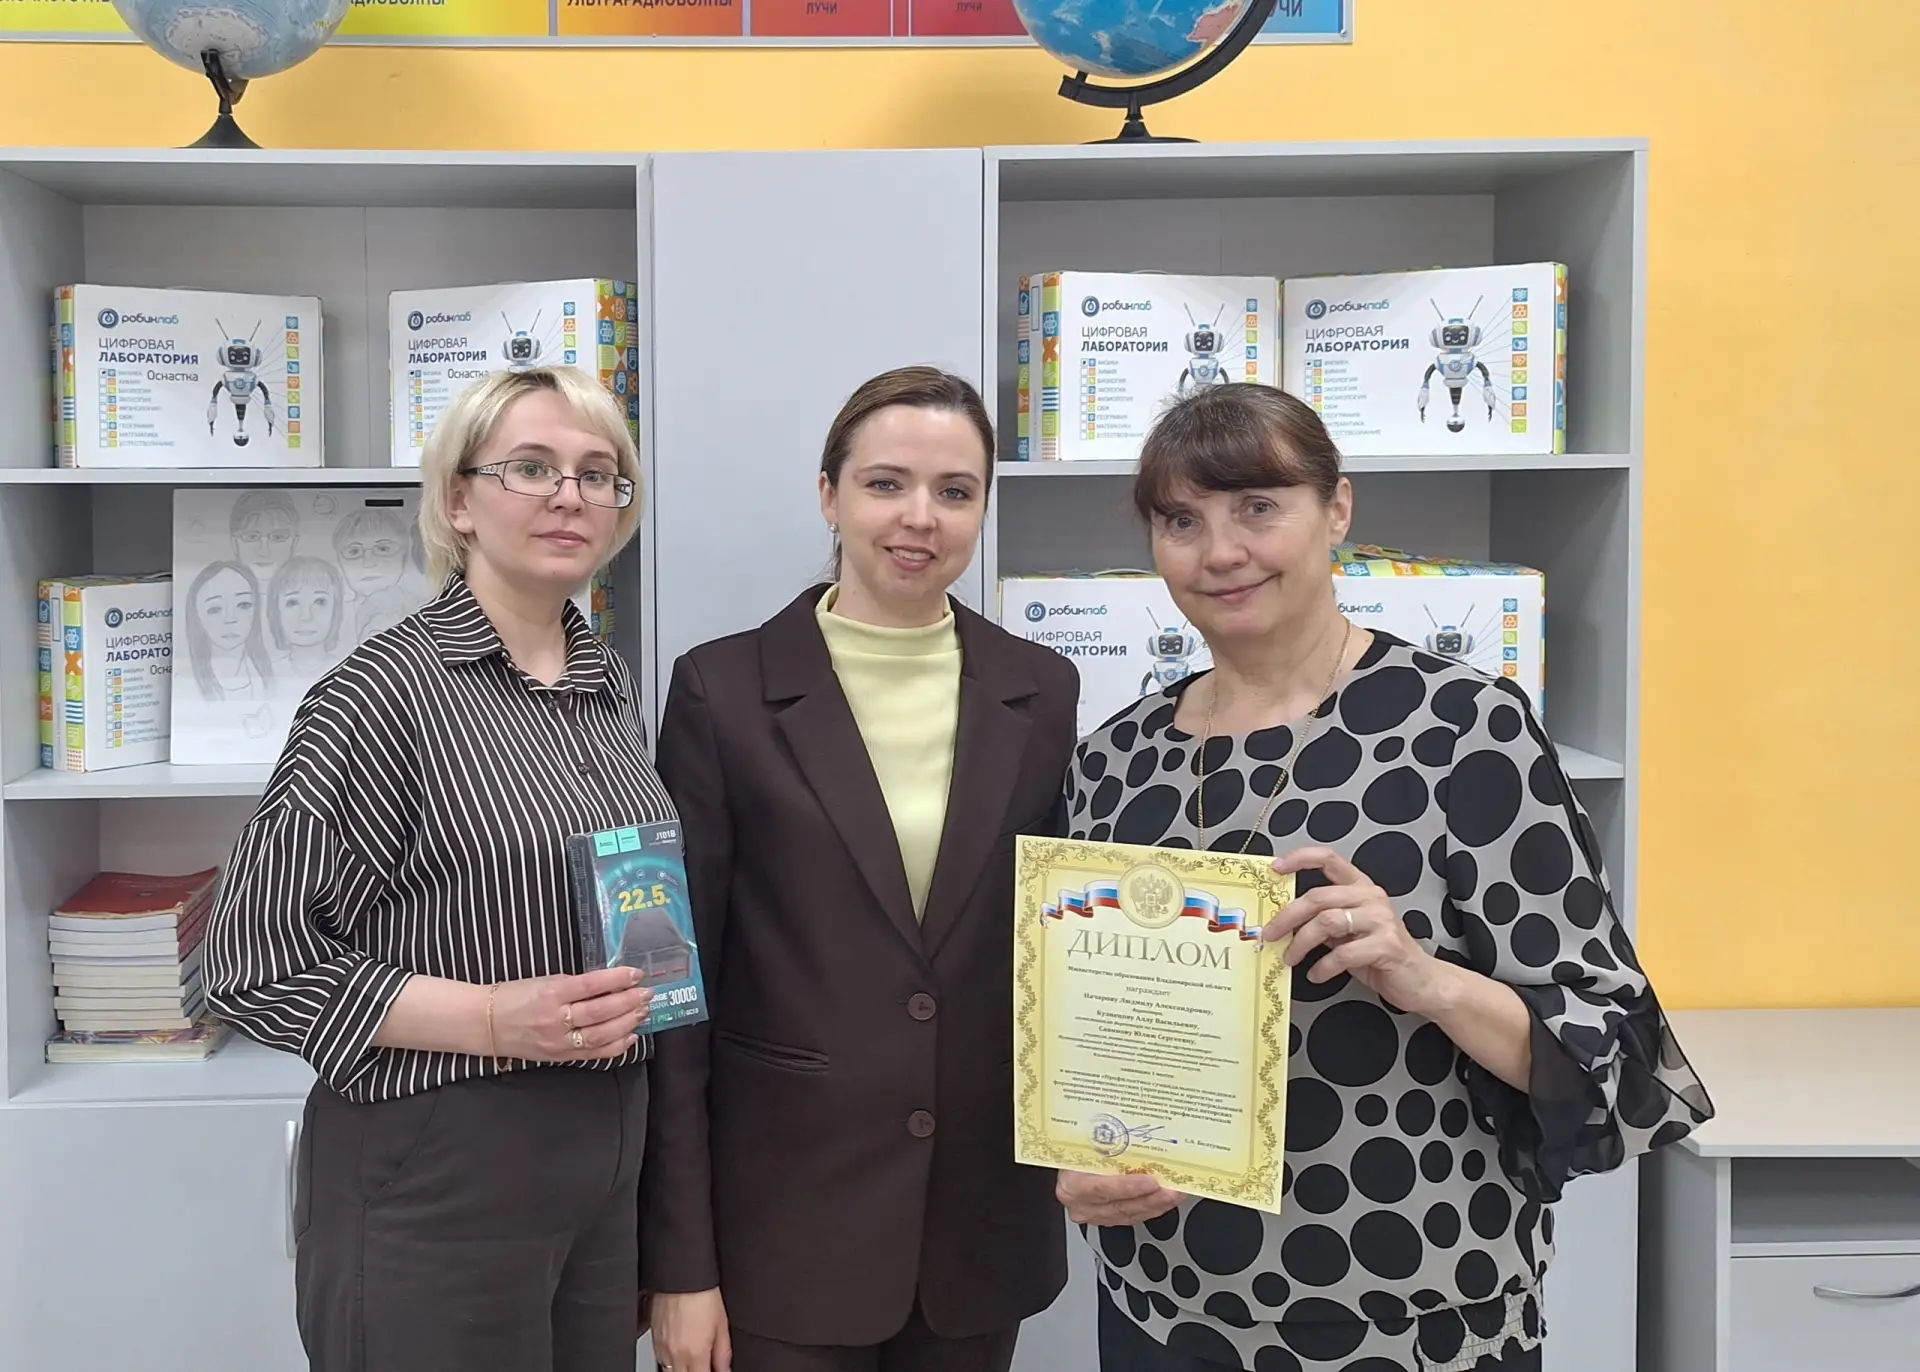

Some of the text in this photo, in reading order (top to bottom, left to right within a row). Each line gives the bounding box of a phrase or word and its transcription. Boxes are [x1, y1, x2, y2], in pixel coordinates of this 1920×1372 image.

[806, 2, 838, 15] ЛУЧИ
[956, 2, 983, 12] ЛУЧИ
[1081, 327, 1148, 338] ЦИФРОВАЯ
[1305, 326, 1384, 340] ЦИФРОВАЯ
[99, 338, 175, 350] ЦИФРОВАЯ
[408, 337, 468, 351] ЦИФРОВАЯ
[1081, 341, 1168, 353] ЛАБОРАТОРИЯ
[1305, 339, 1410, 354] ЛАБОРАТОРИЯ
[98, 352, 199, 366] ЛАБОРАТОРИЯ
[408, 350, 487, 364] ЛАБОРАТОРИЯ
[147, 370, 199, 382] Оснастка
[106, 632, 173, 648] ЦИФРОВАЯ
[1025, 631, 1102, 642] ЦИФРОВАЯ
[106, 647, 172, 662] ЛАБОРАТО
[1053, 645, 1127, 656] ОРАТОРИЯ
[656, 829, 676, 840] J101B
[1067, 928, 1232, 971] ДИПЛОМ
